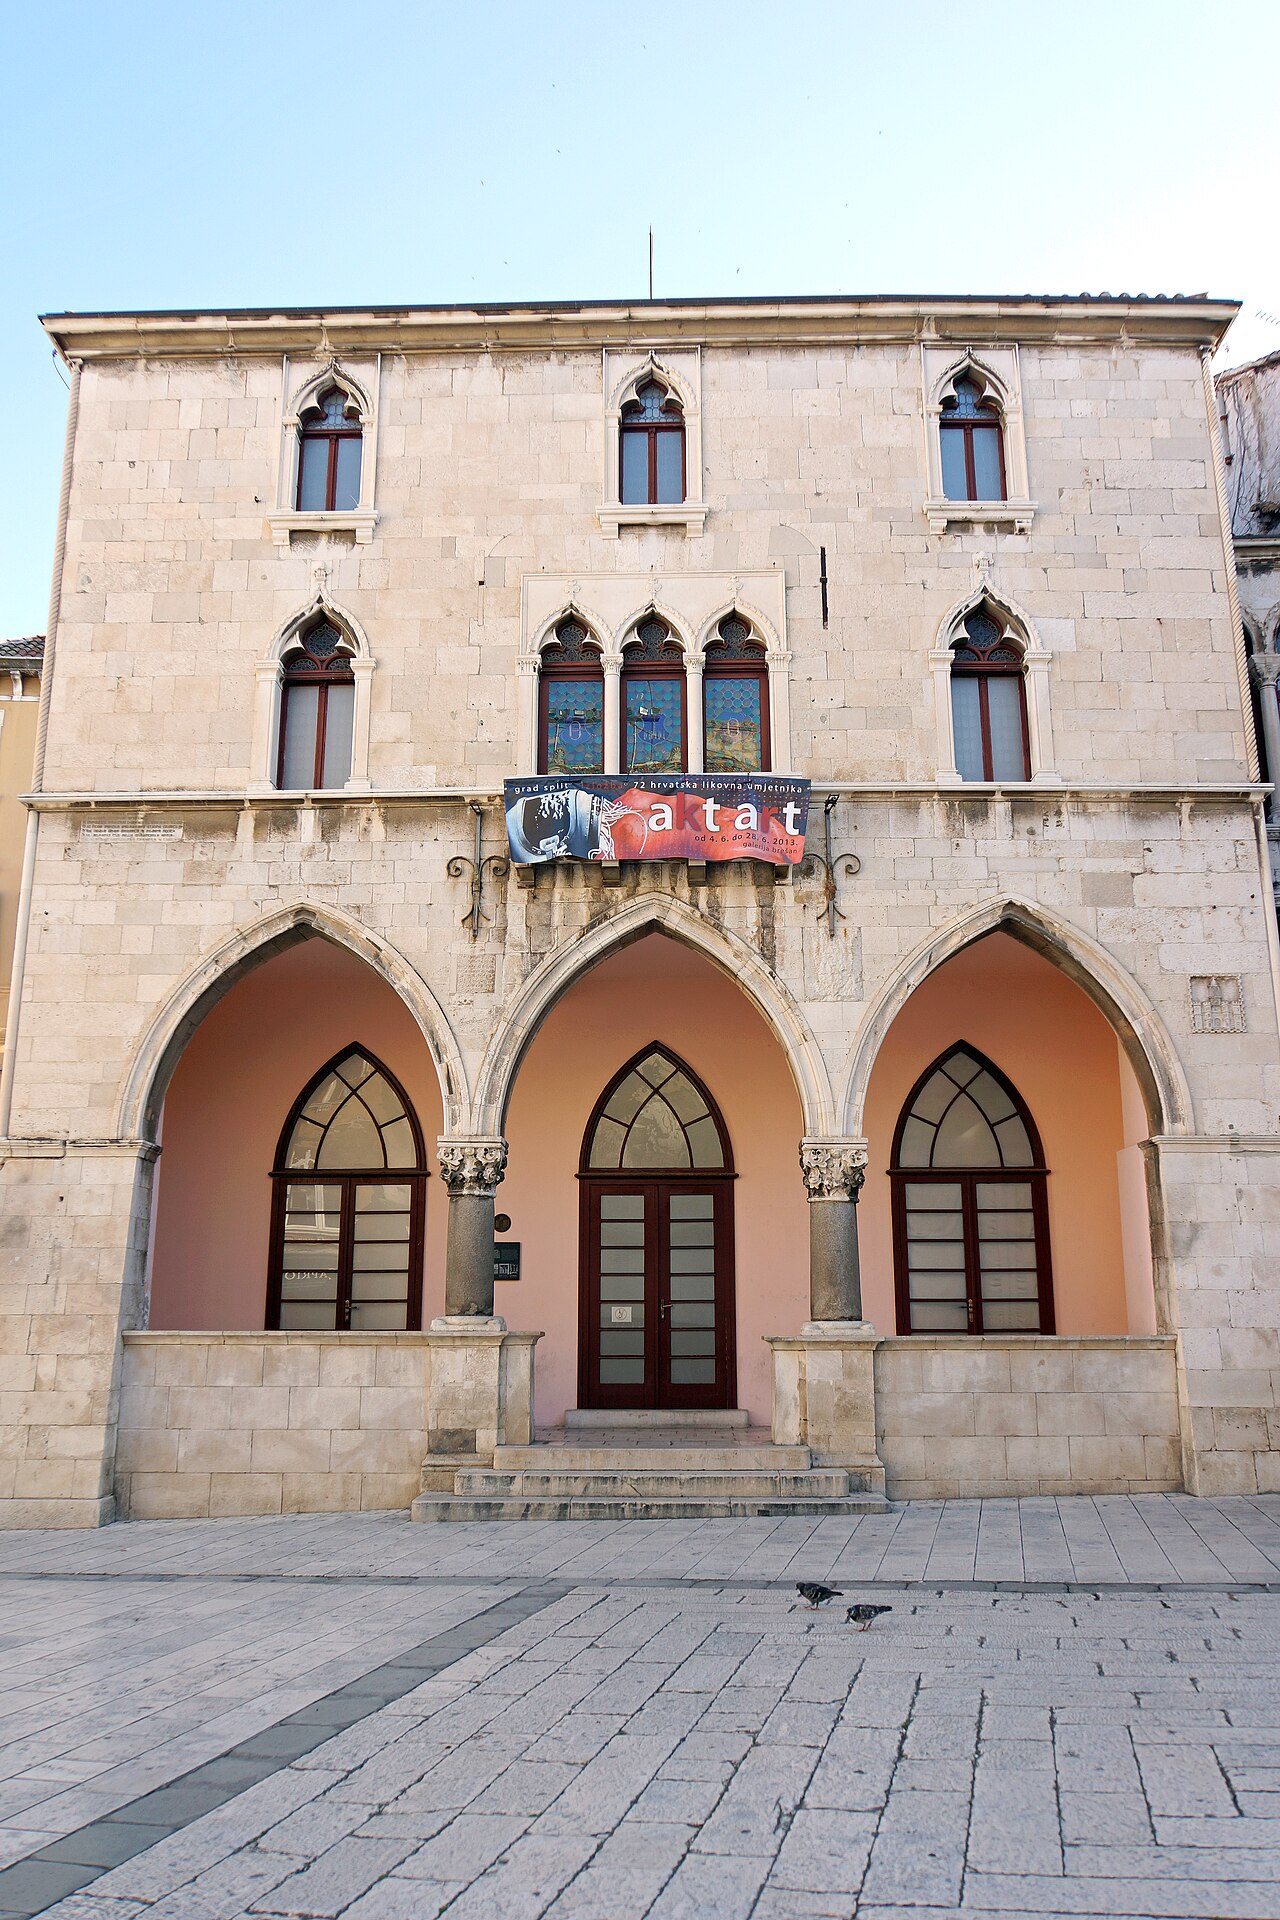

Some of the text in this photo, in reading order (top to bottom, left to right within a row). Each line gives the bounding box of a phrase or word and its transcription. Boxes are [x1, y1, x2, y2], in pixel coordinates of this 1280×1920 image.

[514, 784, 539, 795] grad
[543, 782, 569, 793] split
[633, 781, 646, 789] 72
[650, 781, 697, 789] hrvatska
[702, 780, 742, 790] likovna
[747, 782, 802, 793] umjetnika
[648, 792, 802, 836] akt art
[732, 833, 743, 841] do
[746, 832, 759, 841] 28.
[773, 838, 798, 846] 2013.
[742, 842, 770, 852] galerija
